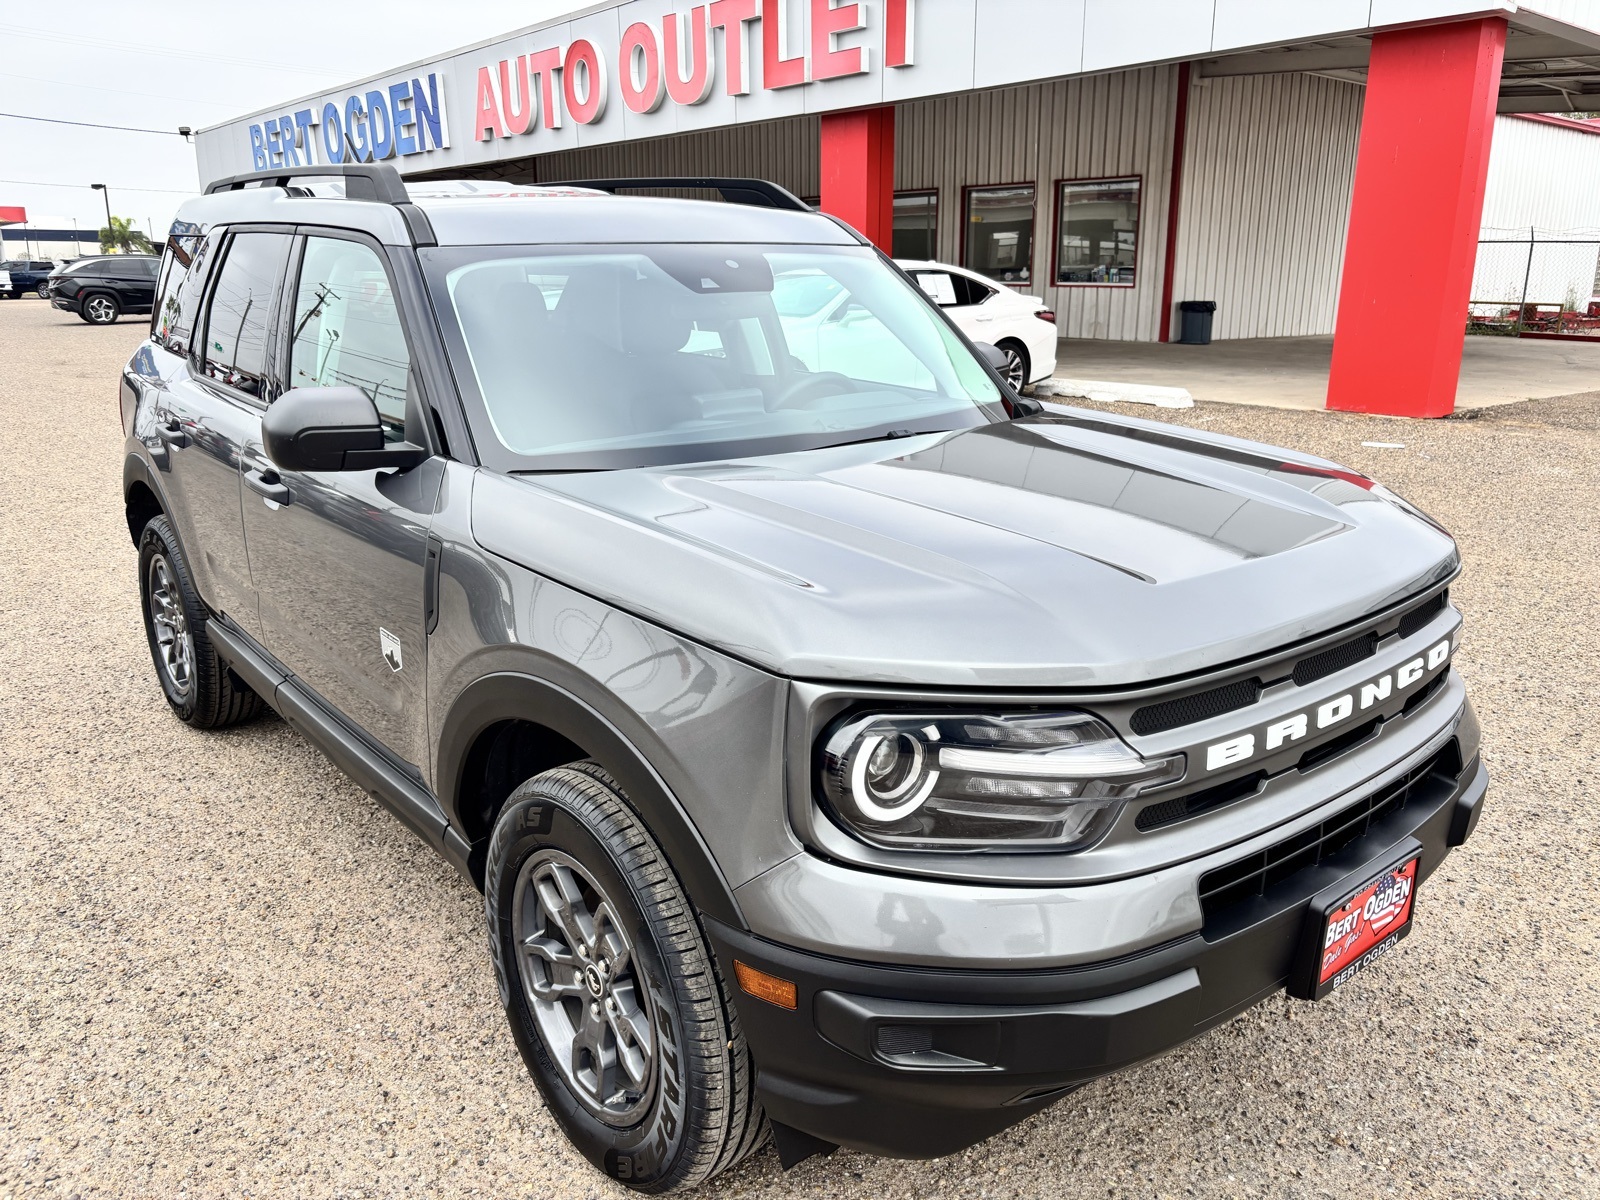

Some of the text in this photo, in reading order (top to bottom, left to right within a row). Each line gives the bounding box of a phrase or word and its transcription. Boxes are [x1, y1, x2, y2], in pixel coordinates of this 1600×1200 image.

[249, 108, 319, 171] BERT
[322, 72, 450, 165] OGDEN
[475, 39, 606, 142] AUTO
[1206, 640, 1449, 771] BRONCO
[1325, 907, 1362, 949] BERT
[1363, 876, 1412, 921] OGDEN
[1332, 932, 1399, 989] BERT OGDEN
[617, 1002, 683, 1179] STARFIRE
